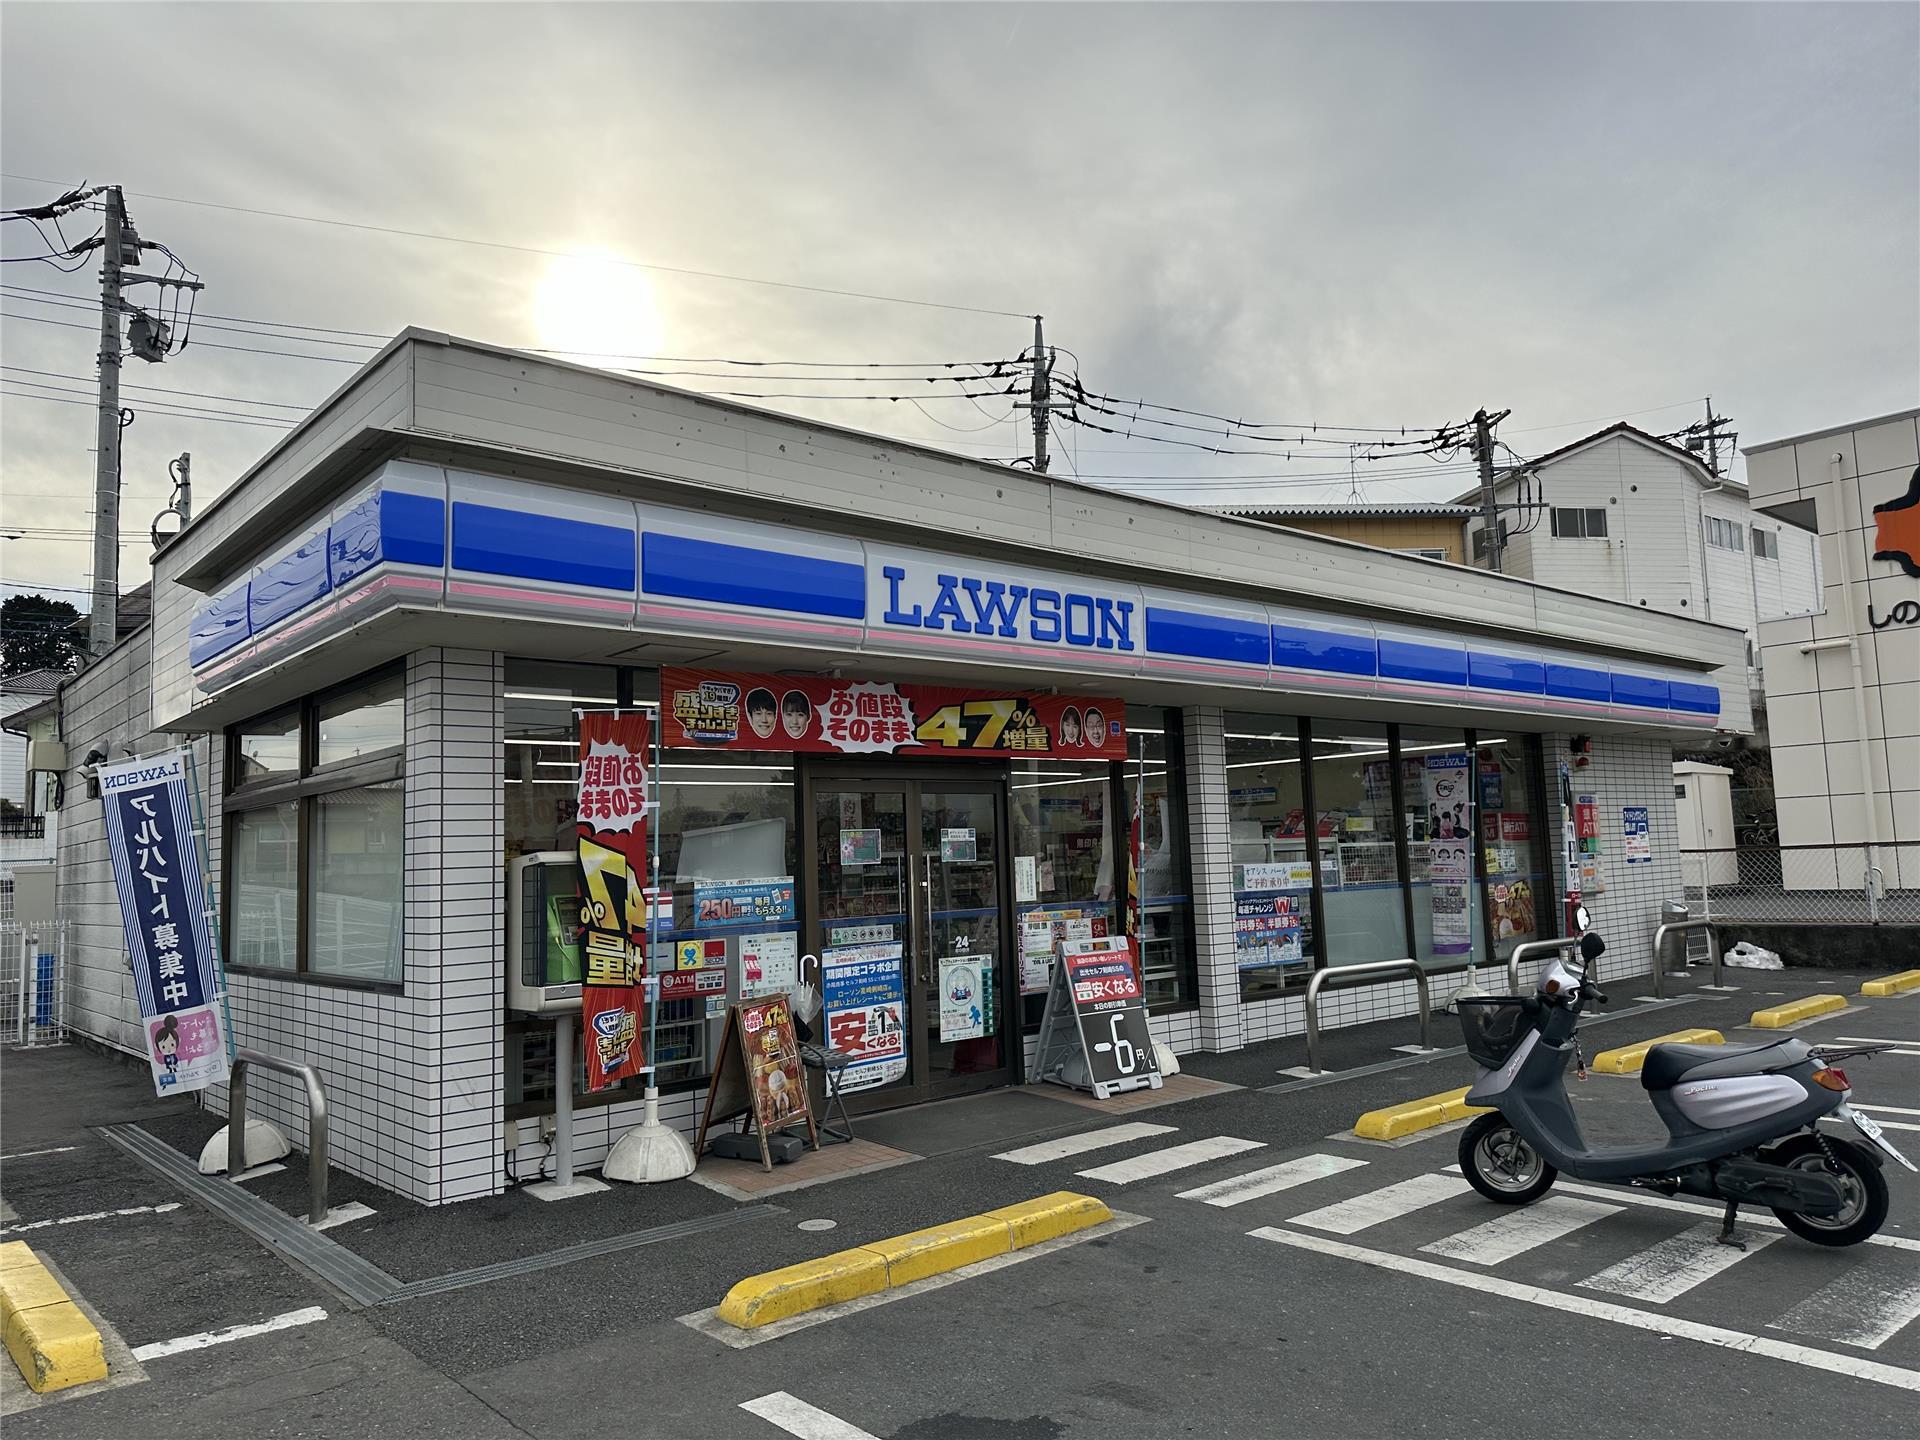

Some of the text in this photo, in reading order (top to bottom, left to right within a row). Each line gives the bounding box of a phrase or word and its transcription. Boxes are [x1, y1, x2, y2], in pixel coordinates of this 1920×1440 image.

[883, 566, 1134, 650] LAWSON
[1868, 601, 1920, 628] しの
[676, 692, 738, 719] 盛りすぎ
[829, 691, 905, 719] お値段
[686, 719, 736, 730] チャレンジ
[827, 718, 911, 743] そのまま
[1003, 727, 1049, 750] 増量
[955, 936, 969, 948] 24
[674, 975, 695, 985] ATM
[1091, 978, 1136, 998] 安くなる
